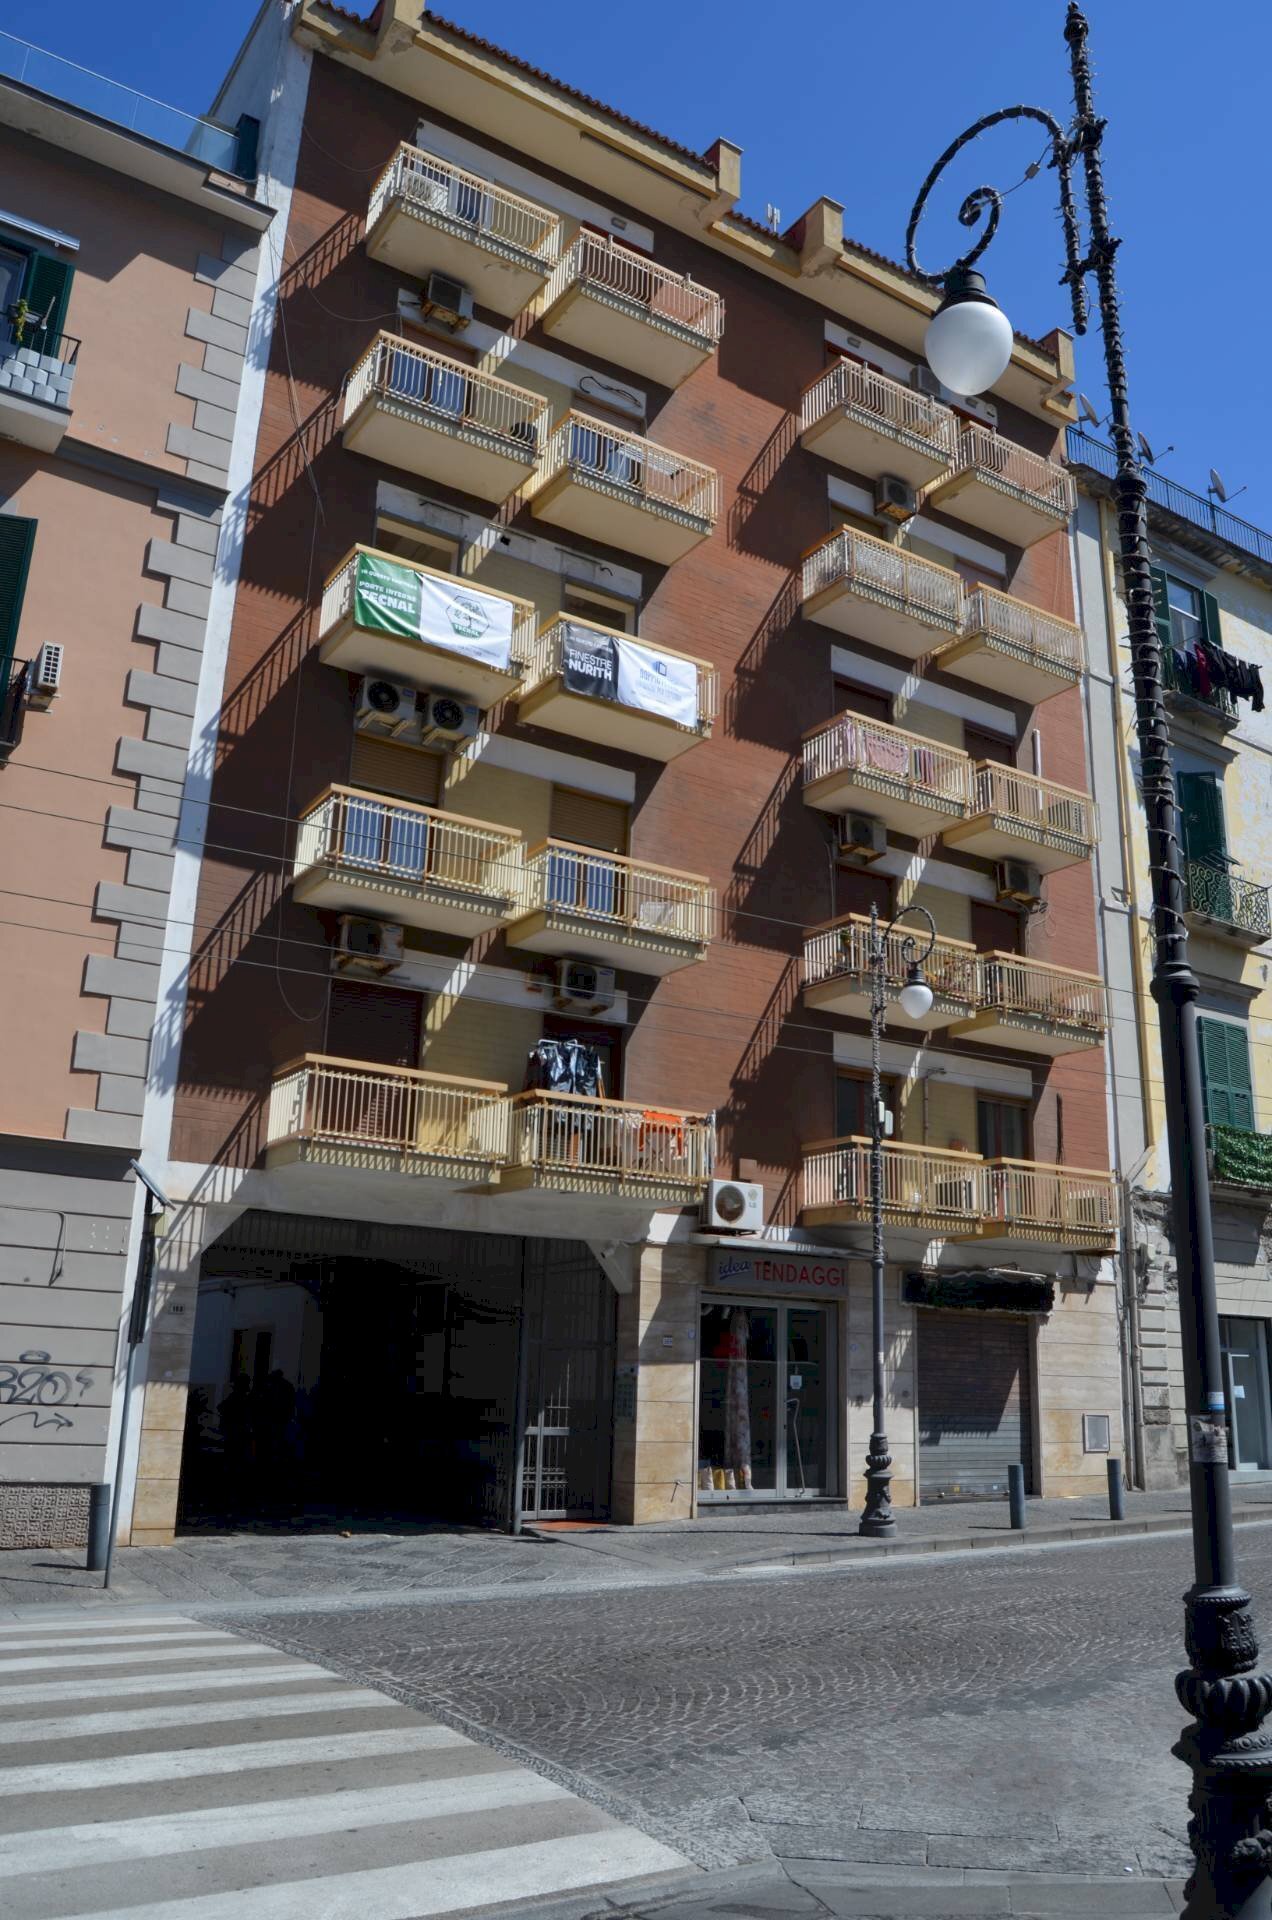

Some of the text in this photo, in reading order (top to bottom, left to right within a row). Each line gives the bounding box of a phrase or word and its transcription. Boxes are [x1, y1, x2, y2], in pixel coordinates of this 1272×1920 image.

[568, 659, 613, 682] NURITH
[569, 649, 613, 670] FINESTRE
[719, 1256, 848, 1287] idea TENDAGGI
